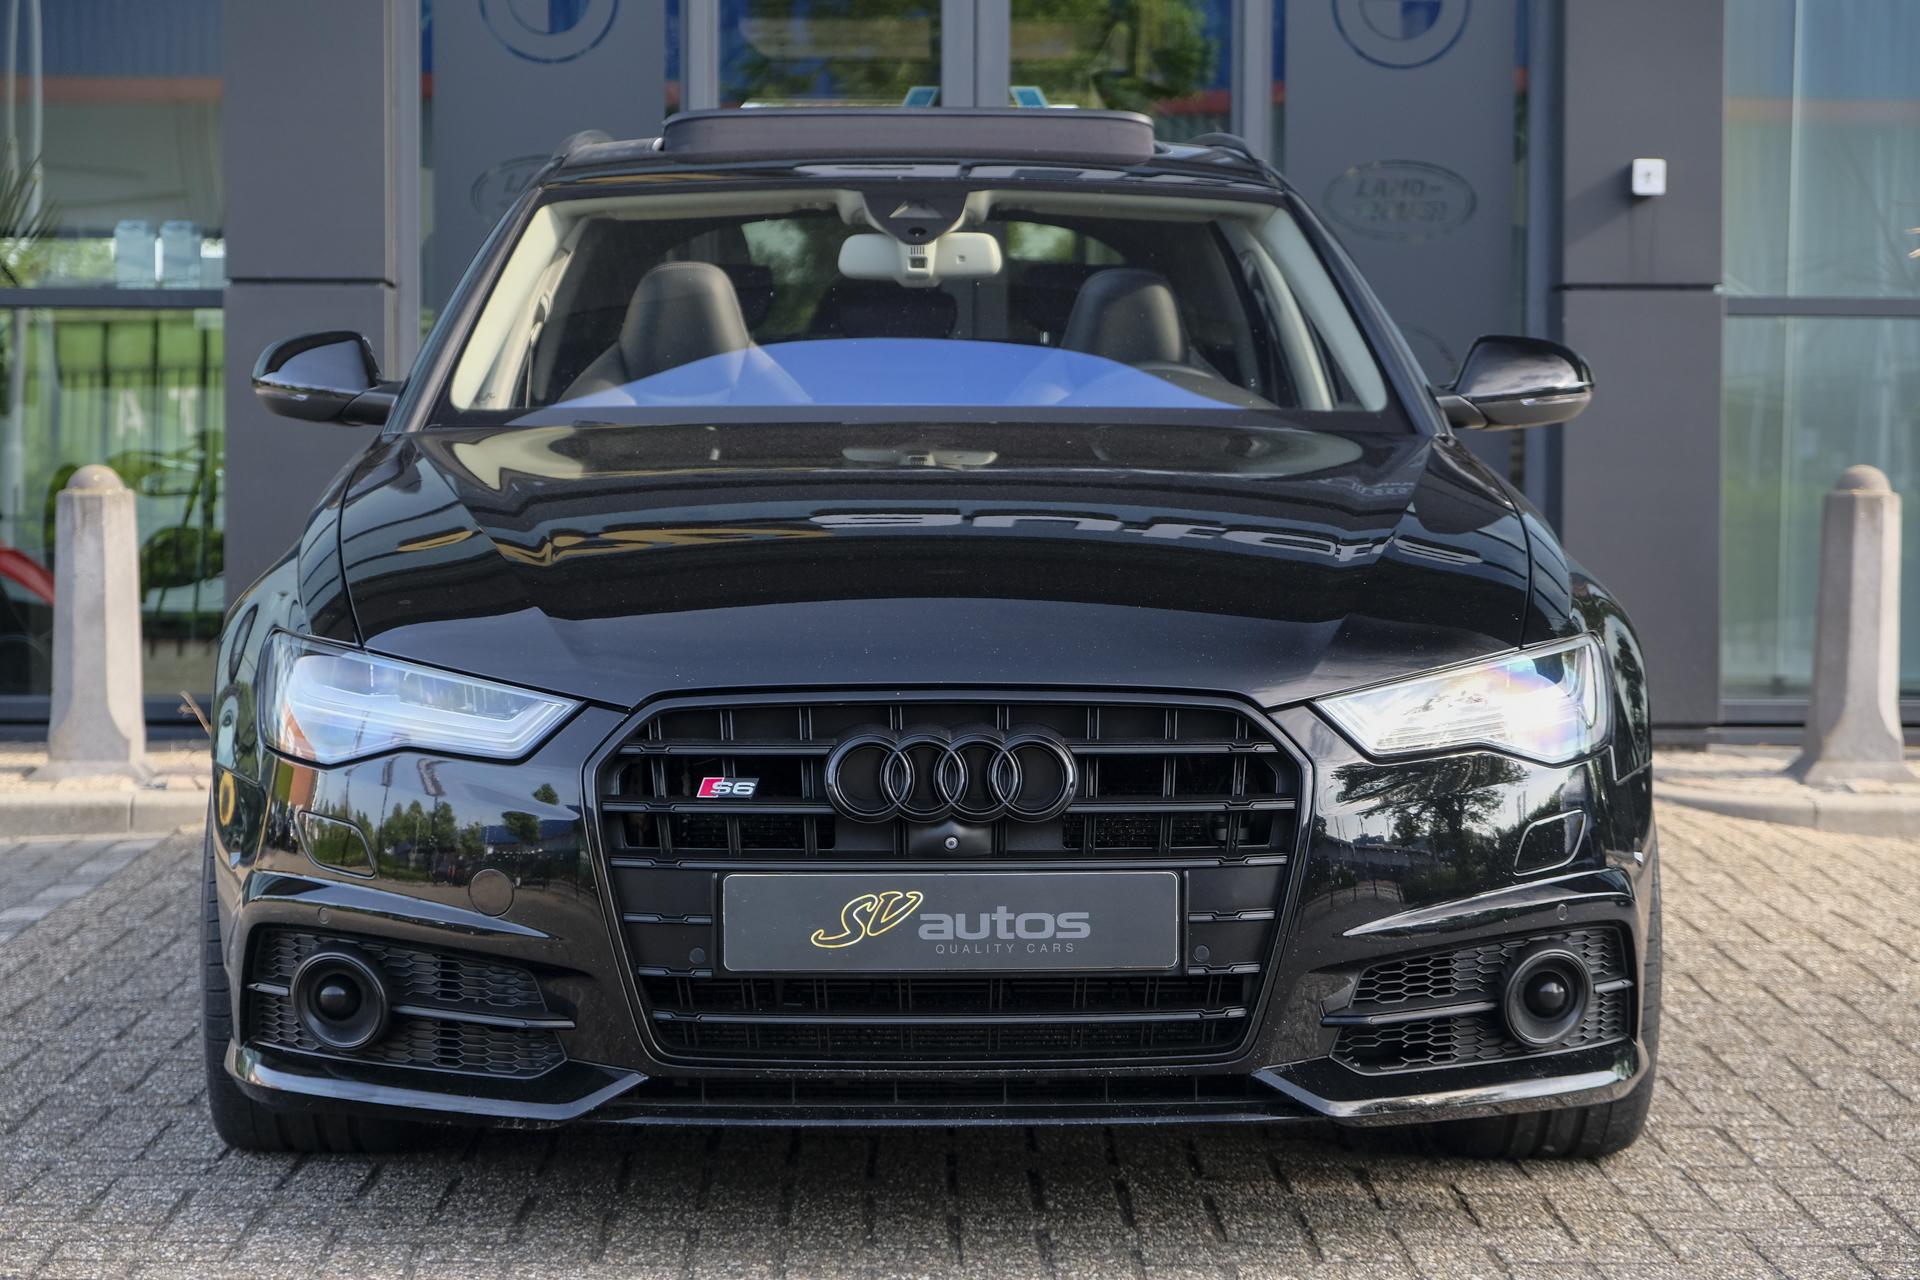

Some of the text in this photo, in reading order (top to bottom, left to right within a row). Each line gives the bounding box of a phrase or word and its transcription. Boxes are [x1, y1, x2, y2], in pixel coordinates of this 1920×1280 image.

[710, 781, 756, 795] S6
[918, 905, 1091, 940] autos
[935, 942, 1075, 954] QUALITY CARS
